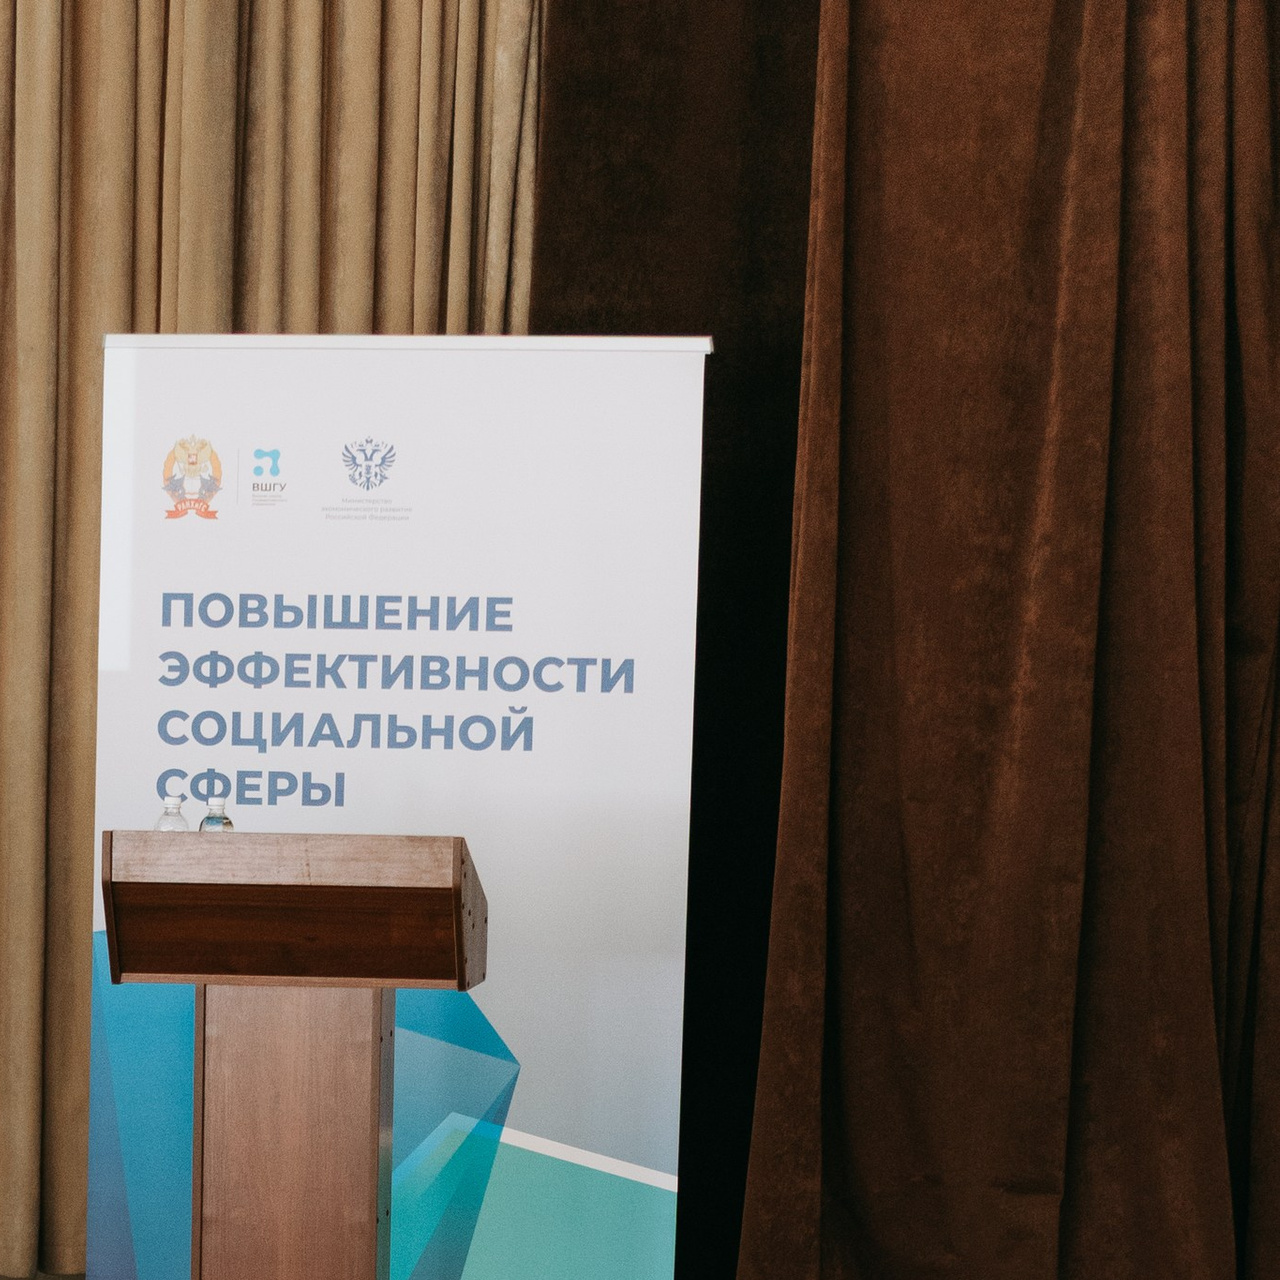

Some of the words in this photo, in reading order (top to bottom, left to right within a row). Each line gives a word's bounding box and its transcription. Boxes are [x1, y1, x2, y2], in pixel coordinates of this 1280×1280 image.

[252, 482, 287, 492] ВШГУ
[161, 592, 514, 632] ПОВЫШЕНИЕ
[158, 650, 636, 694] ЭФФЕКТИВНОСТИ
[157, 706, 535, 754] СОЦИАЛЬНОЙ
[156, 768, 345, 807] СФЕРЫ
